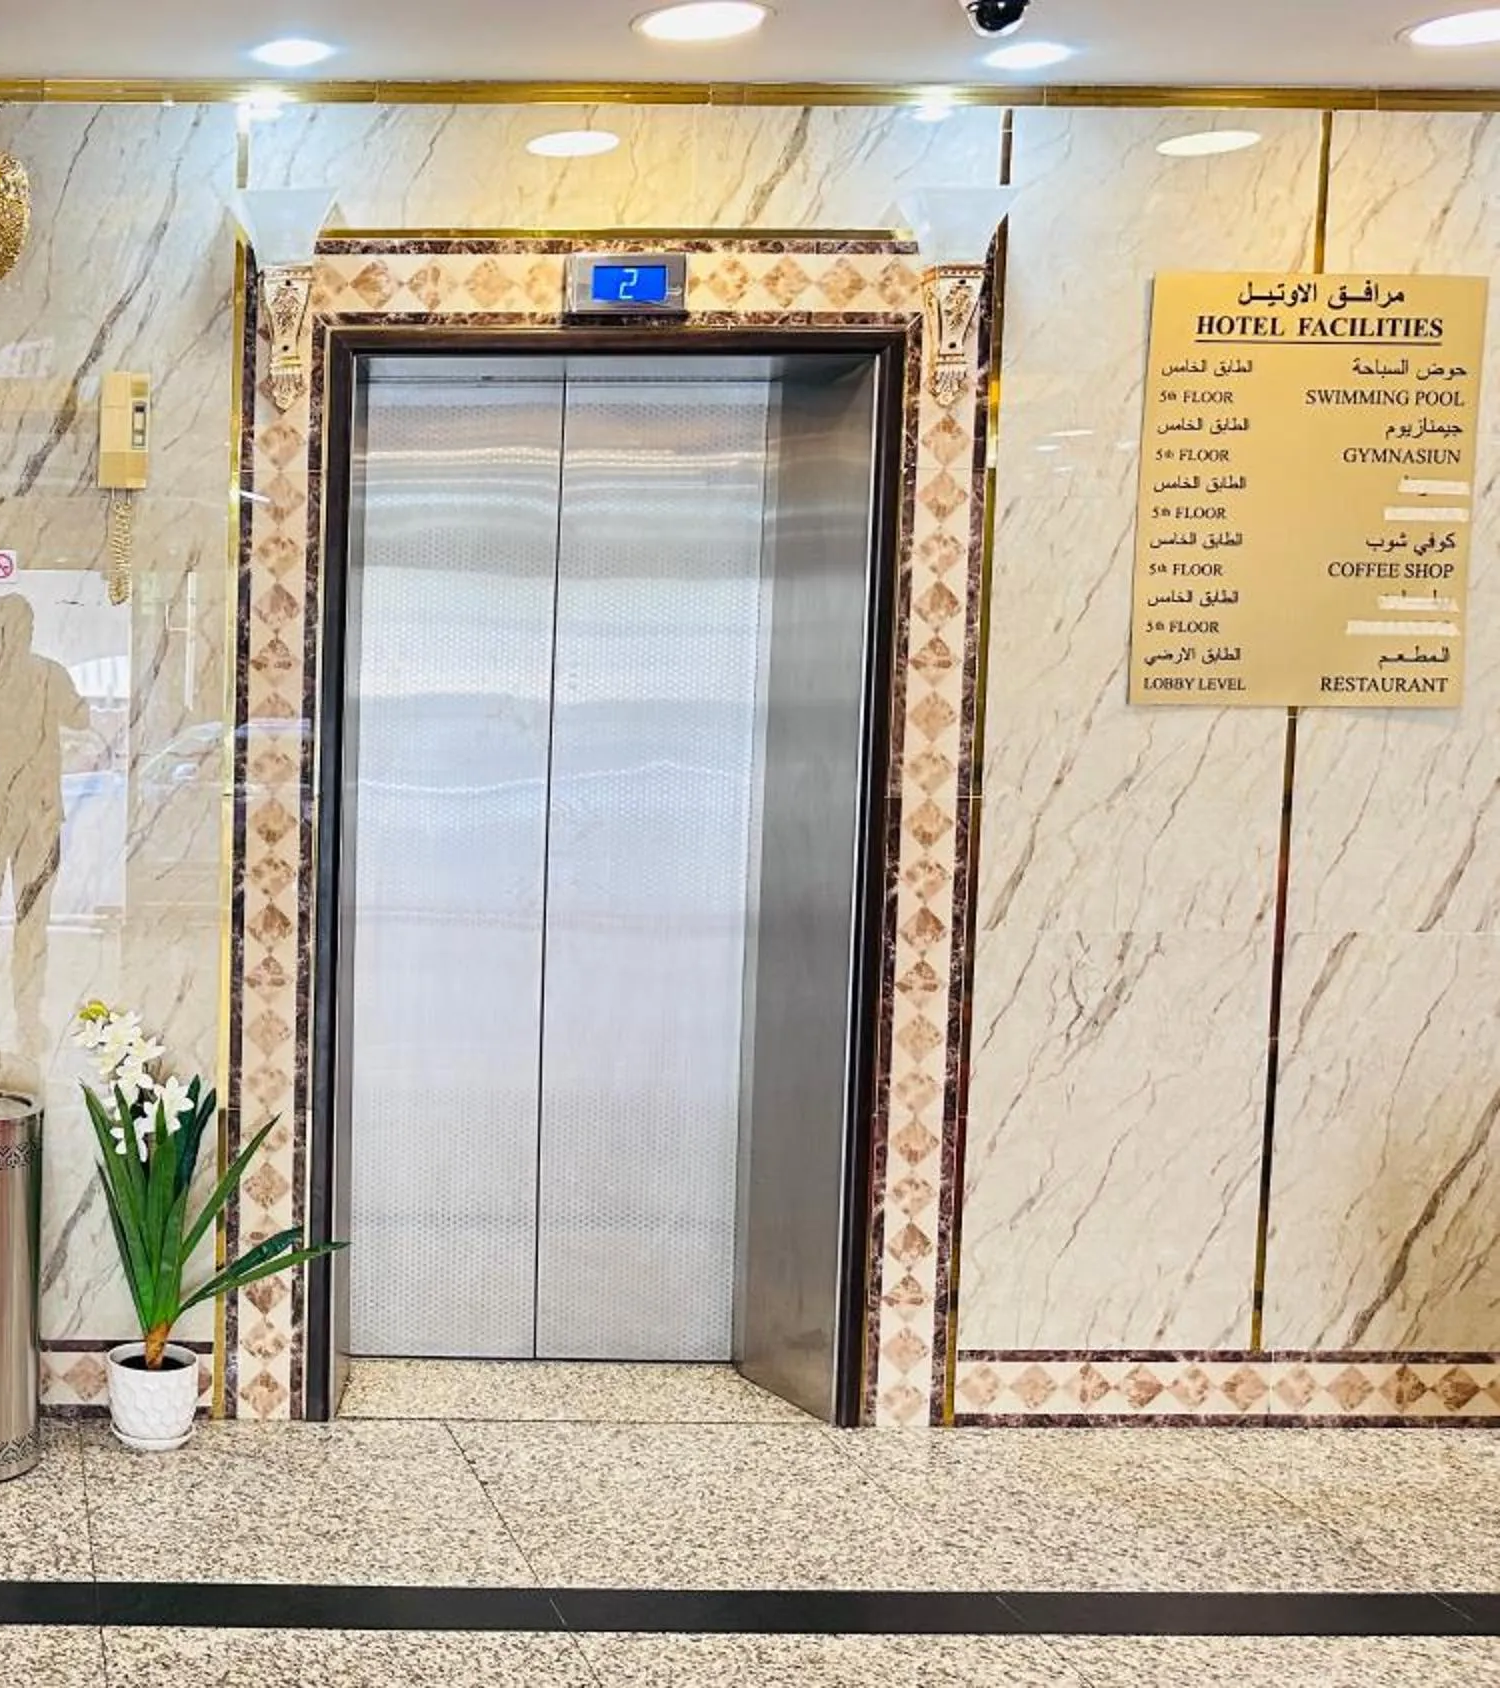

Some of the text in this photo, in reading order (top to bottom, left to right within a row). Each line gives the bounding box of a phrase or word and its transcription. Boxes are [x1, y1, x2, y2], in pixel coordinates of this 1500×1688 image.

[618, 268, 639, 300] 2
[1237, 279, 1405, 310] مرافق الاوتيل
[1196, 315, 1444, 338] HOTEL FACILITIES
[1352, 358, 1467, 380] حوض السباحة
[1183, 391, 1233, 403] FLOOR
[1305, 389, 1465, 406] SWIMMING POOL
[1385, 417, 1463, 440] جيمنازيوم
[1179, 449, 1229, 462] FLOOR
[1343, 447, 1461, 465] GYMNASIUN
[1175, 507, 1226, 519] FLOOR
[1365, 532, 1457, 556] كوفي شوب
[1173, 563, 1223, 576] FLOOR
[1327, 561, 1455, 579] COFFEE SHOP
[1169, 621, 1220, 633] FLOOR
[1377, 645, 1450, 671] المطعم
[1143, 677, 1247, 691] LOBBY LEVEL
[1320, 676, 1448, 693] RESTAURANT
